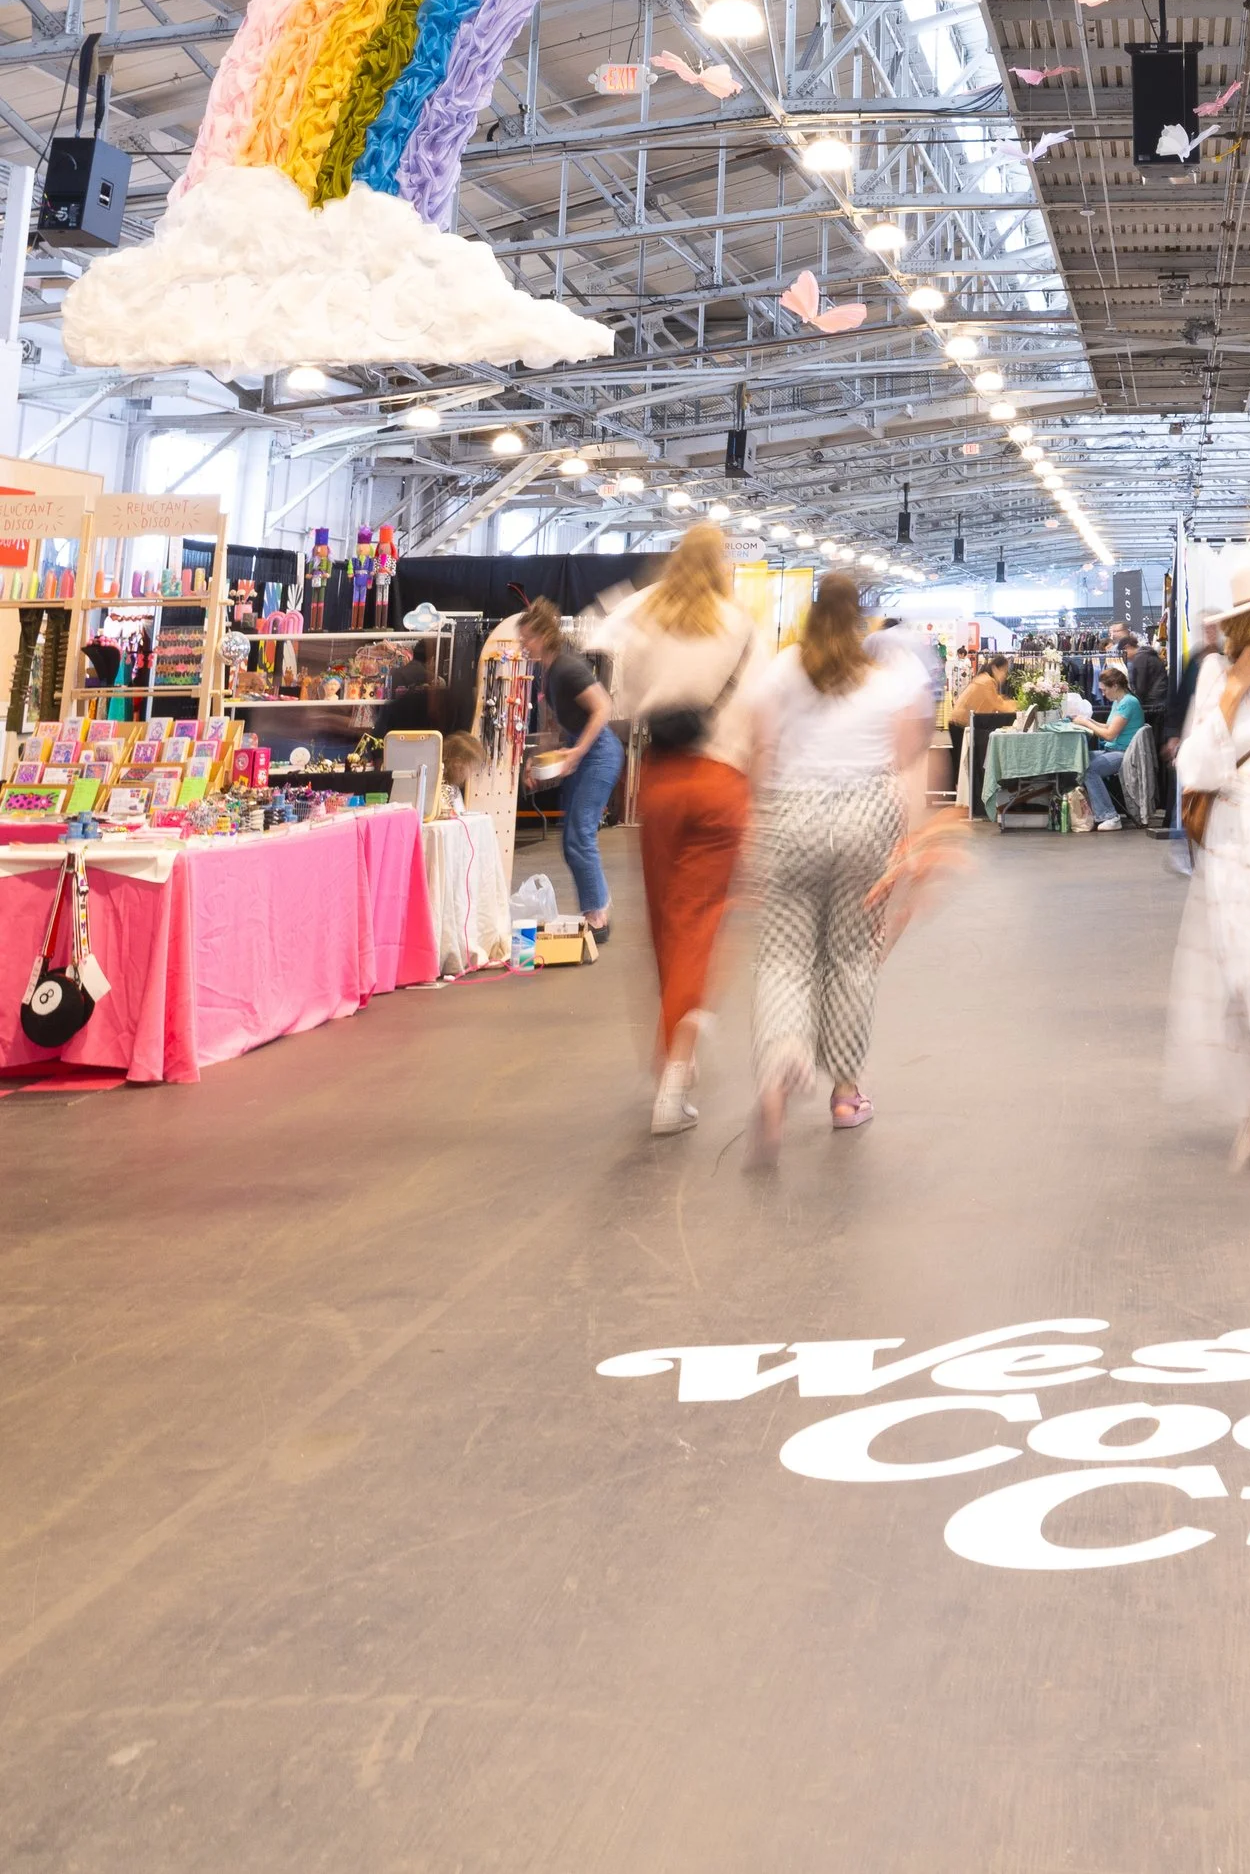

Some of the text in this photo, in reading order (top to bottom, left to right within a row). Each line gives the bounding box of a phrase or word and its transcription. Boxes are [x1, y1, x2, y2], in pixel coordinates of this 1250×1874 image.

[608, 67, 637, 90] EXIT
[0, 501, 53, 517] ELUCTANT
[127, 499, 189, 515] RELUCTANT
[4, 519, 33, 531] DISCO
[141, 516, 171, 529] DISCO
[722, 542, 758, 550] RLOOM
